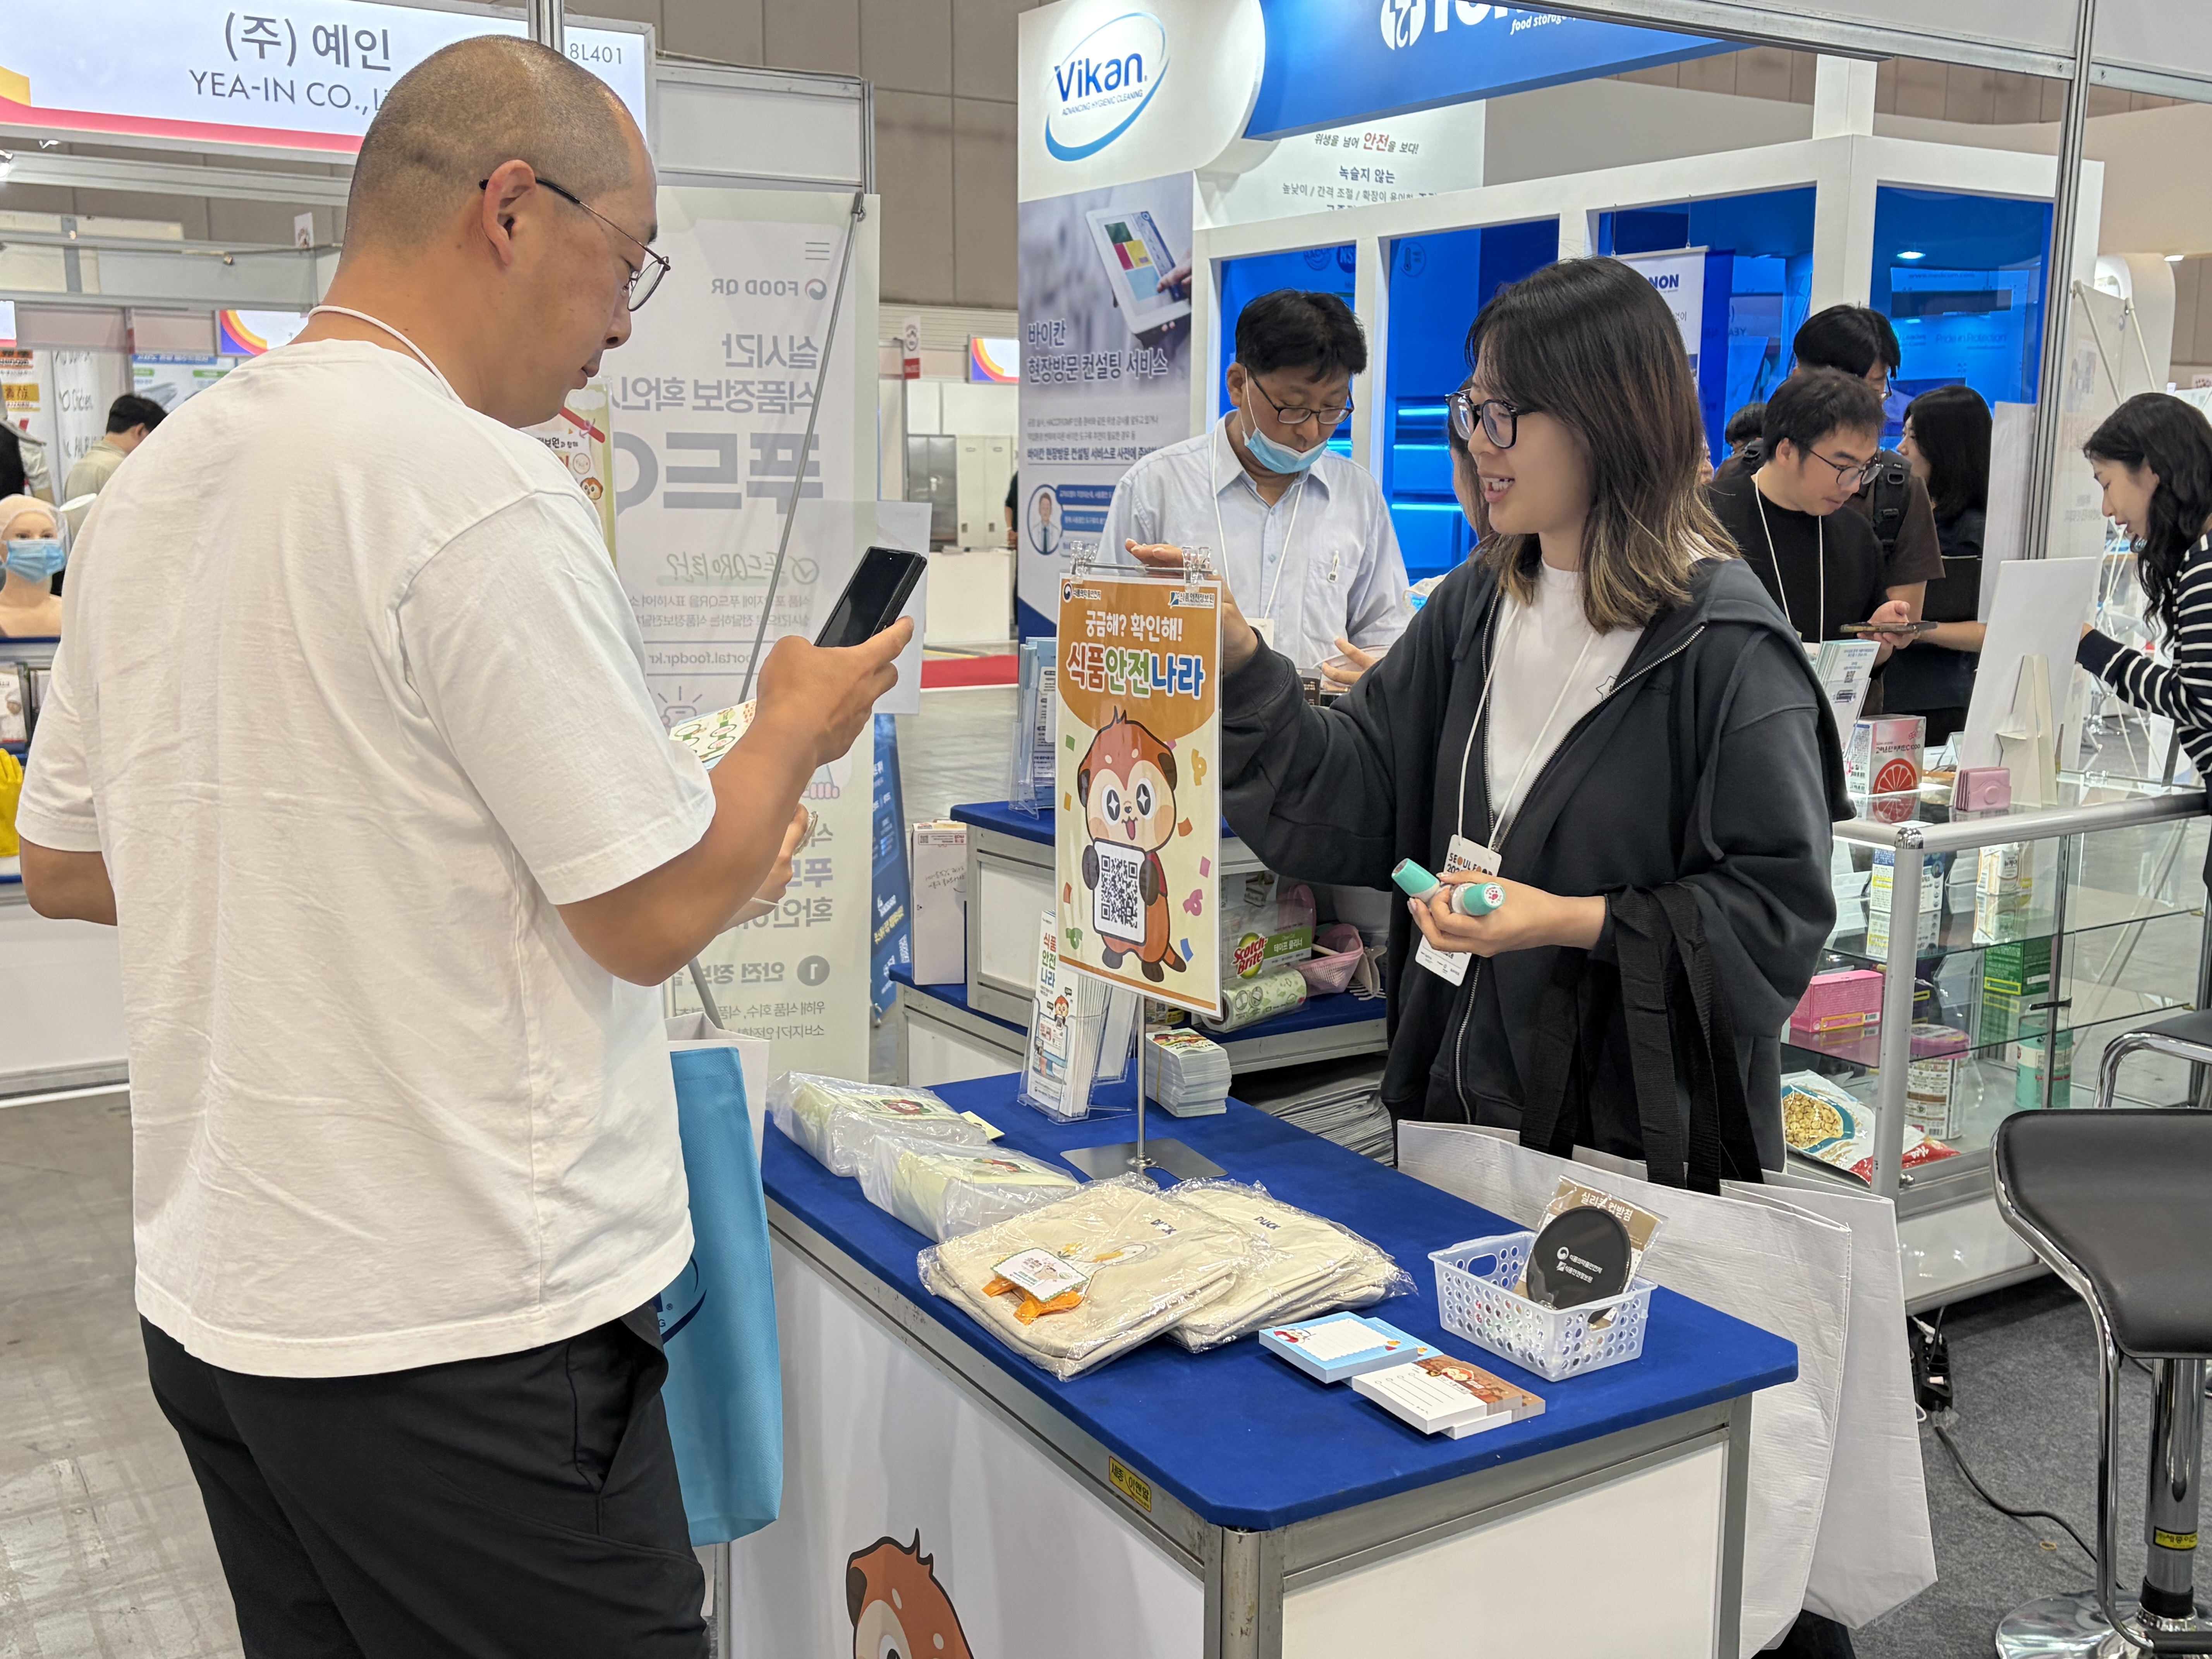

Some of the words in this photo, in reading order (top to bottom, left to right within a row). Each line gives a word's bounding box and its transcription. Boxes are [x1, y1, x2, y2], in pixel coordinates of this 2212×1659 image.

[1510, 16, 1531, 34] food
[225, 12, 297, 67] (주)
[313, 24, 391, 71] 예인
[570, 43, 621, 64] 8L401
[189, 69, 295, 104] YEA-IN
[306, 82, 389, 115] CO.,L
[1315, 133, 1339, 146] 위생을
[1343, 136, 1360, 149] 넘어
[1364, 132, 1396, 153] 안전을
[1399, 142, 1419, 155] 보다!
[1339, 165, 1370, 182] 녹슬지
[1374, 169, 1395, 184] 않는
[1028, 319, 1066, 349] 바이칸
[1028, 354, 1079, 384] 현장방문
[1082, 350, 1123, 381] 컨설팅
[1126, 347, 1168, 380] 서비스
[1085, 610, 1127, 637] 궁금해?
[1130, 613, 1183, 642] 확인해!
[1066, 641, 1206, 700] 식품안전나라
[1448, 852, 1471, 871] SEOUL
[1043, 932, 1056, 953] 식품
[1042, 950, 1056, 970] 안전
[1237, 950, 1264, 975] Brite
[1041, 967, 1055, 988] 나라
[1608, 1202, 1633, 1222] 컵받침
[1253, 1216, 1281, 1230] DUCK
